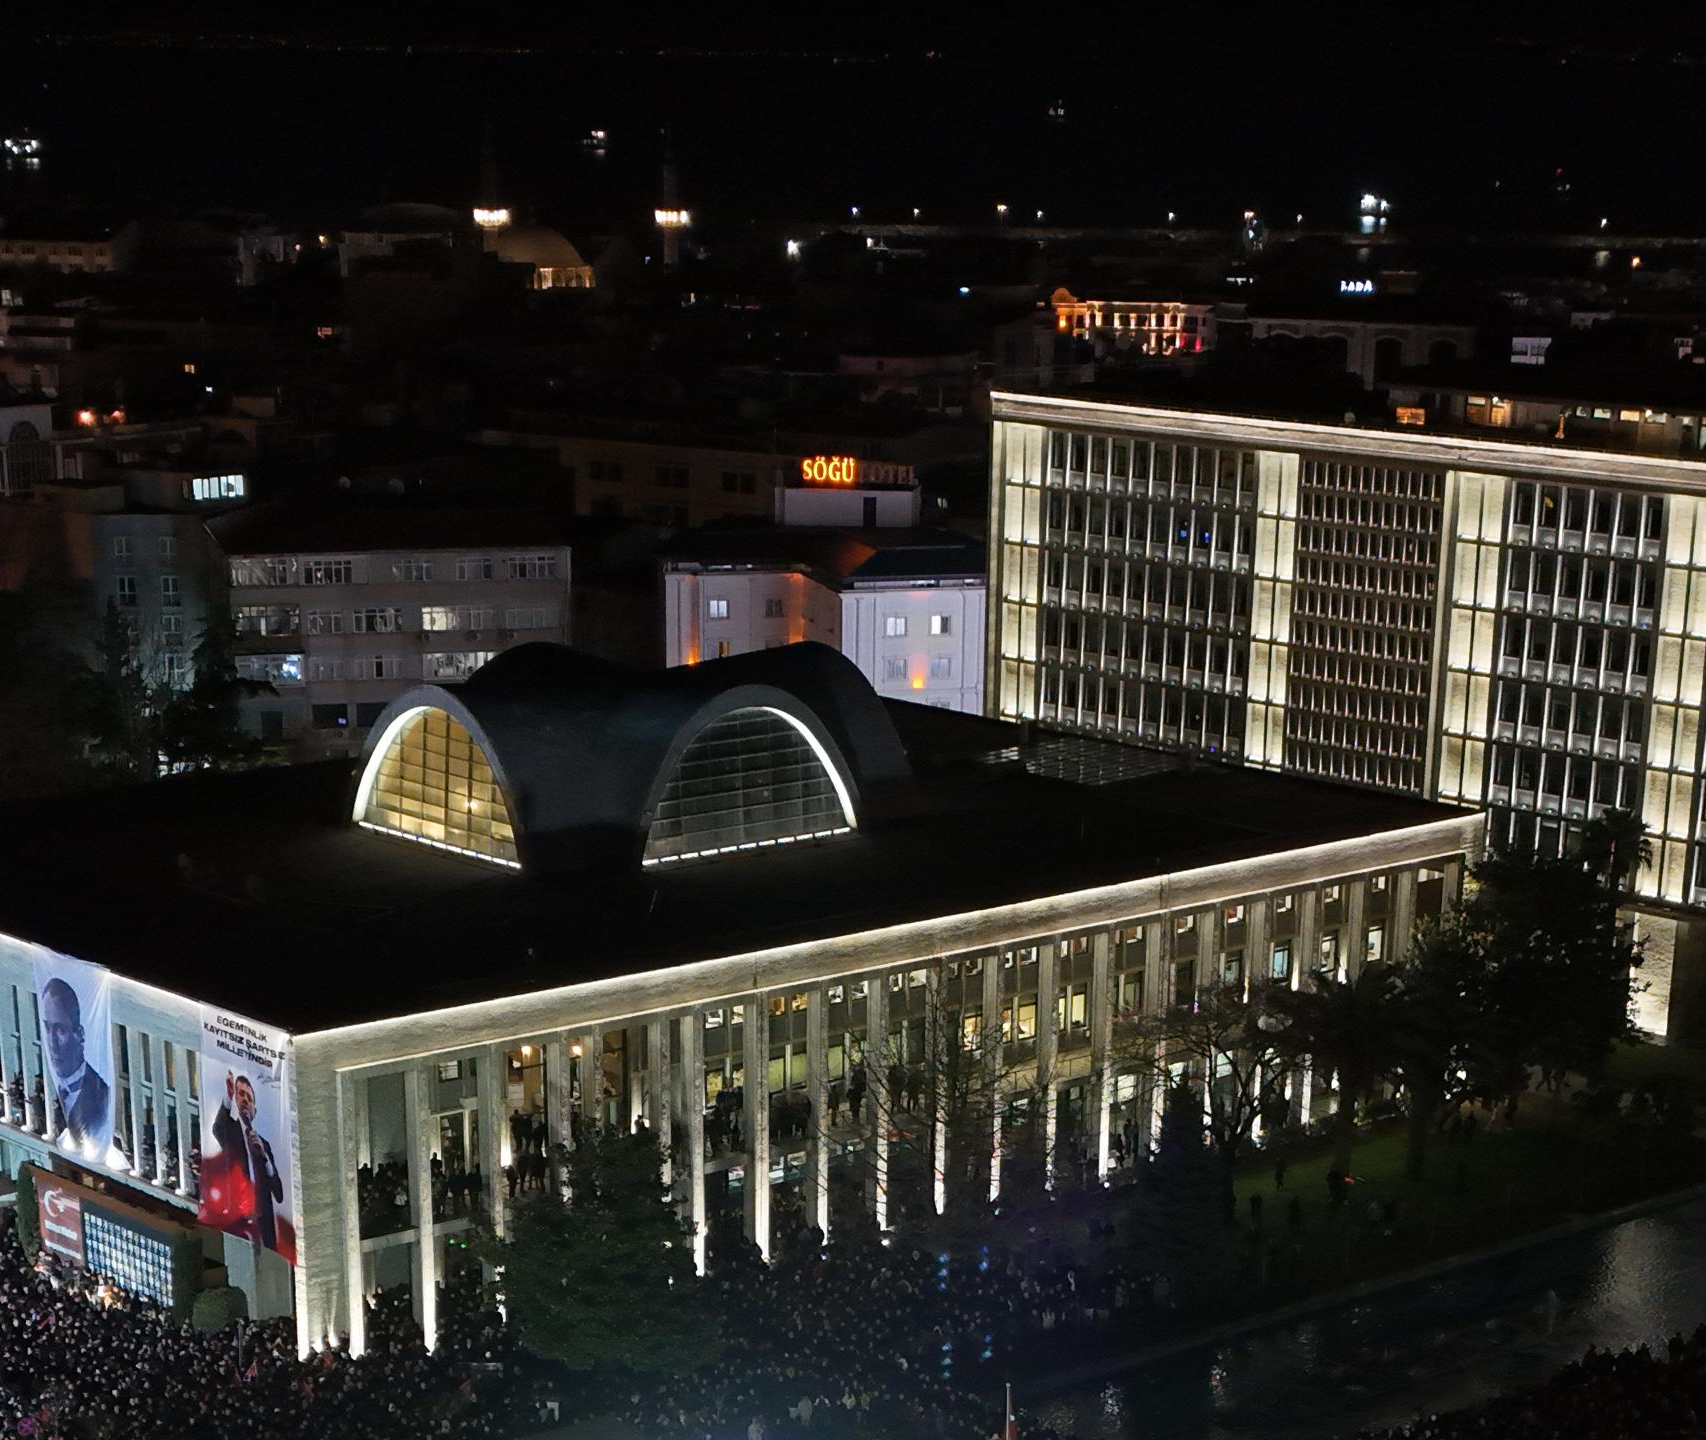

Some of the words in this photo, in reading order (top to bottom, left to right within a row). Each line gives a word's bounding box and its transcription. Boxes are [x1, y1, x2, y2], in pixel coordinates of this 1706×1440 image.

[203, 1021, 245, 1045] KAYITSIZ
[216, 1015, 268, 1042] EGEMENLİK
[216, 1040, 273, 1069] MİLLETİNDİR
